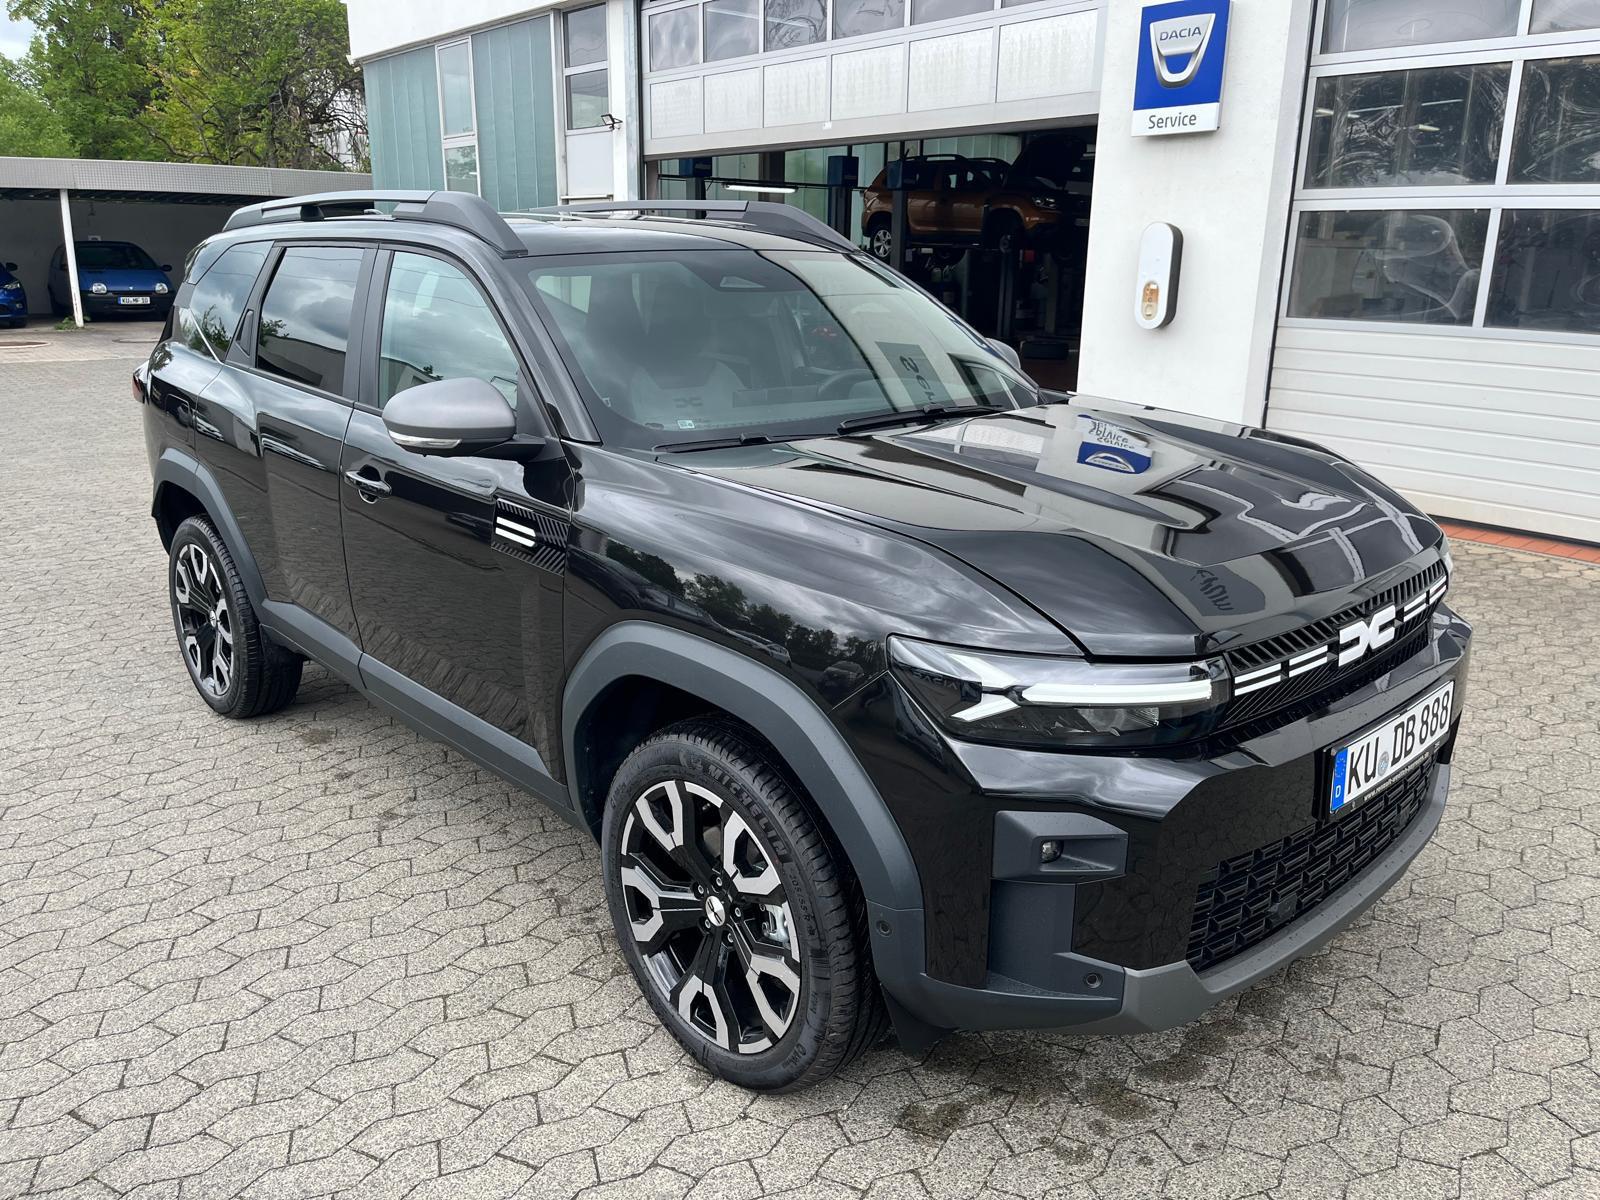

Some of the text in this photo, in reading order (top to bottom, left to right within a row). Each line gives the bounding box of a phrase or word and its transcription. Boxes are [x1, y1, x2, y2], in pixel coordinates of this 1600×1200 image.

[1159, 26, 1202, 41] DACIA
[1148, 112, 1197, 130] Service
[1348, 736, 1380, 795] KU
[1391, 713, 1416, 768] DB
[1419, 690, 1450, 745] 888
[1335, 784, 1341, 799] D
[706, 763, 789, 857] MICHELIN
